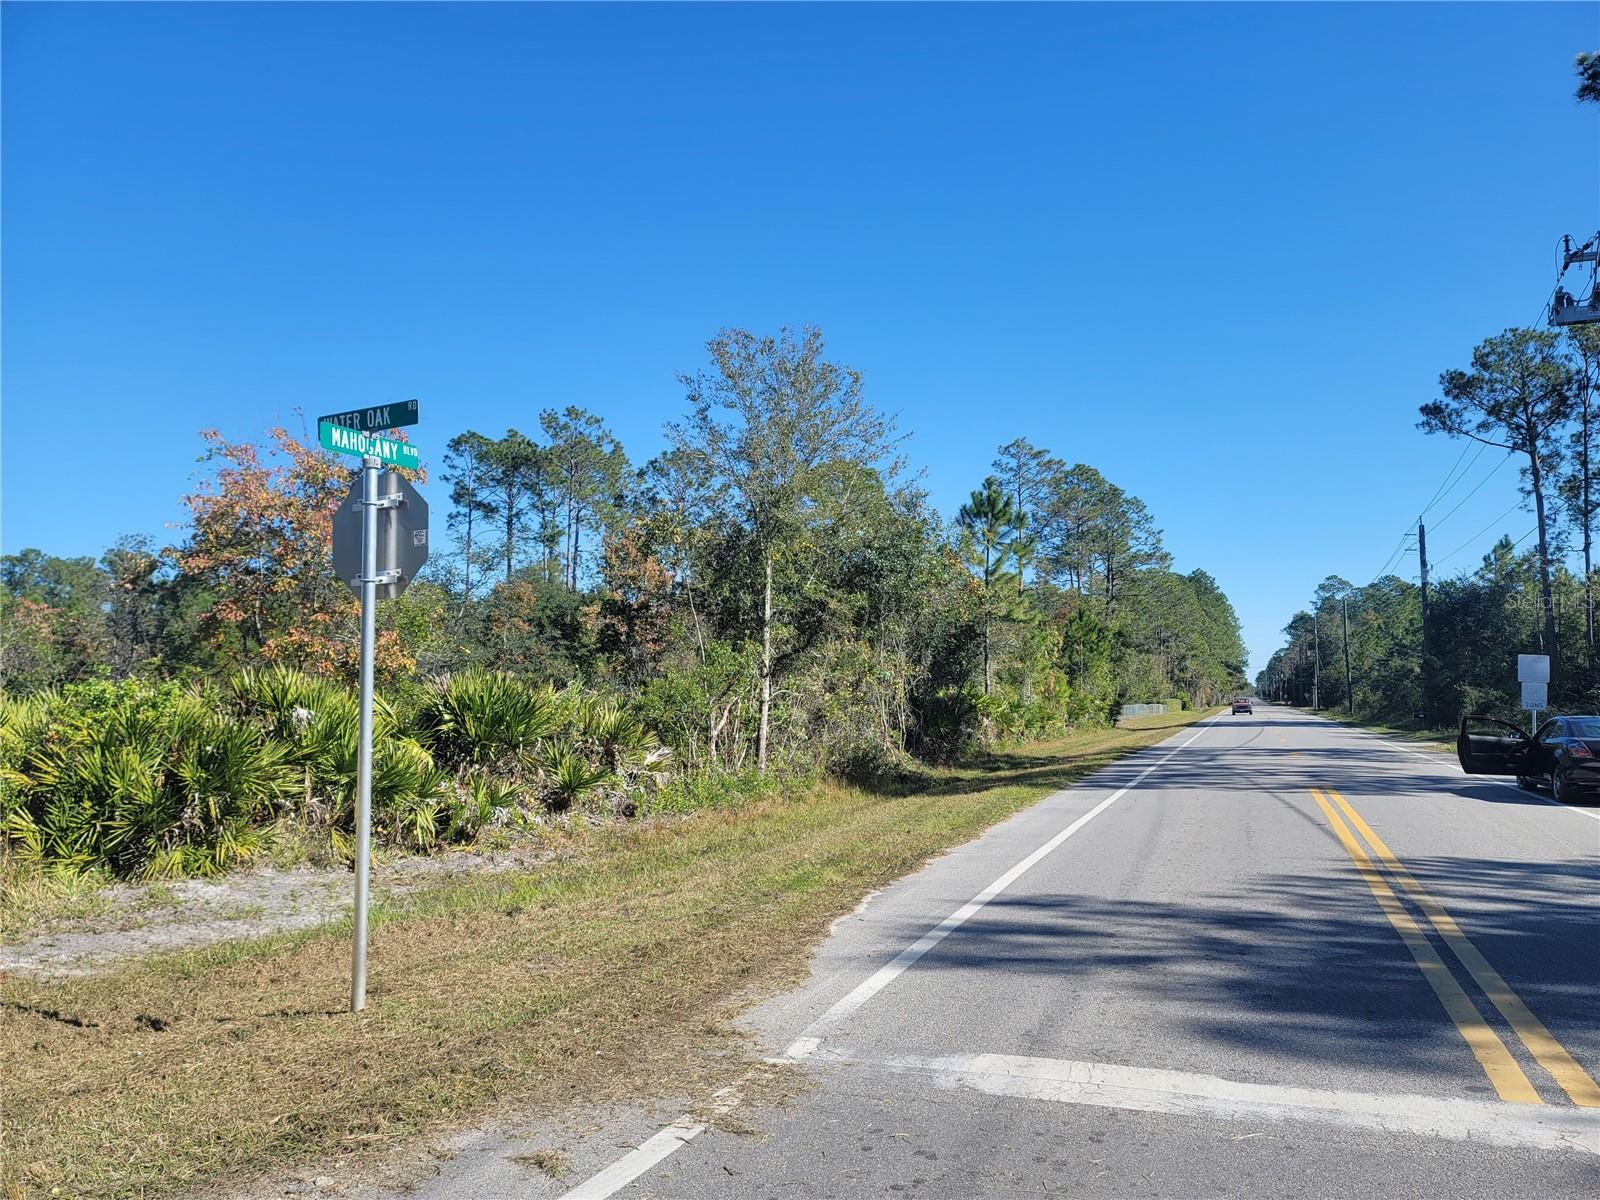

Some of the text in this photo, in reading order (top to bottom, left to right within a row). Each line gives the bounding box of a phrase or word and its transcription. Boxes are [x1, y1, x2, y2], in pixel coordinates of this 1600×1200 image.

[367, 407, 391, 428] OAK
[408, 401, 417, 411] RD
[331, 427, 418, 461] MAHOGANY BLVD
